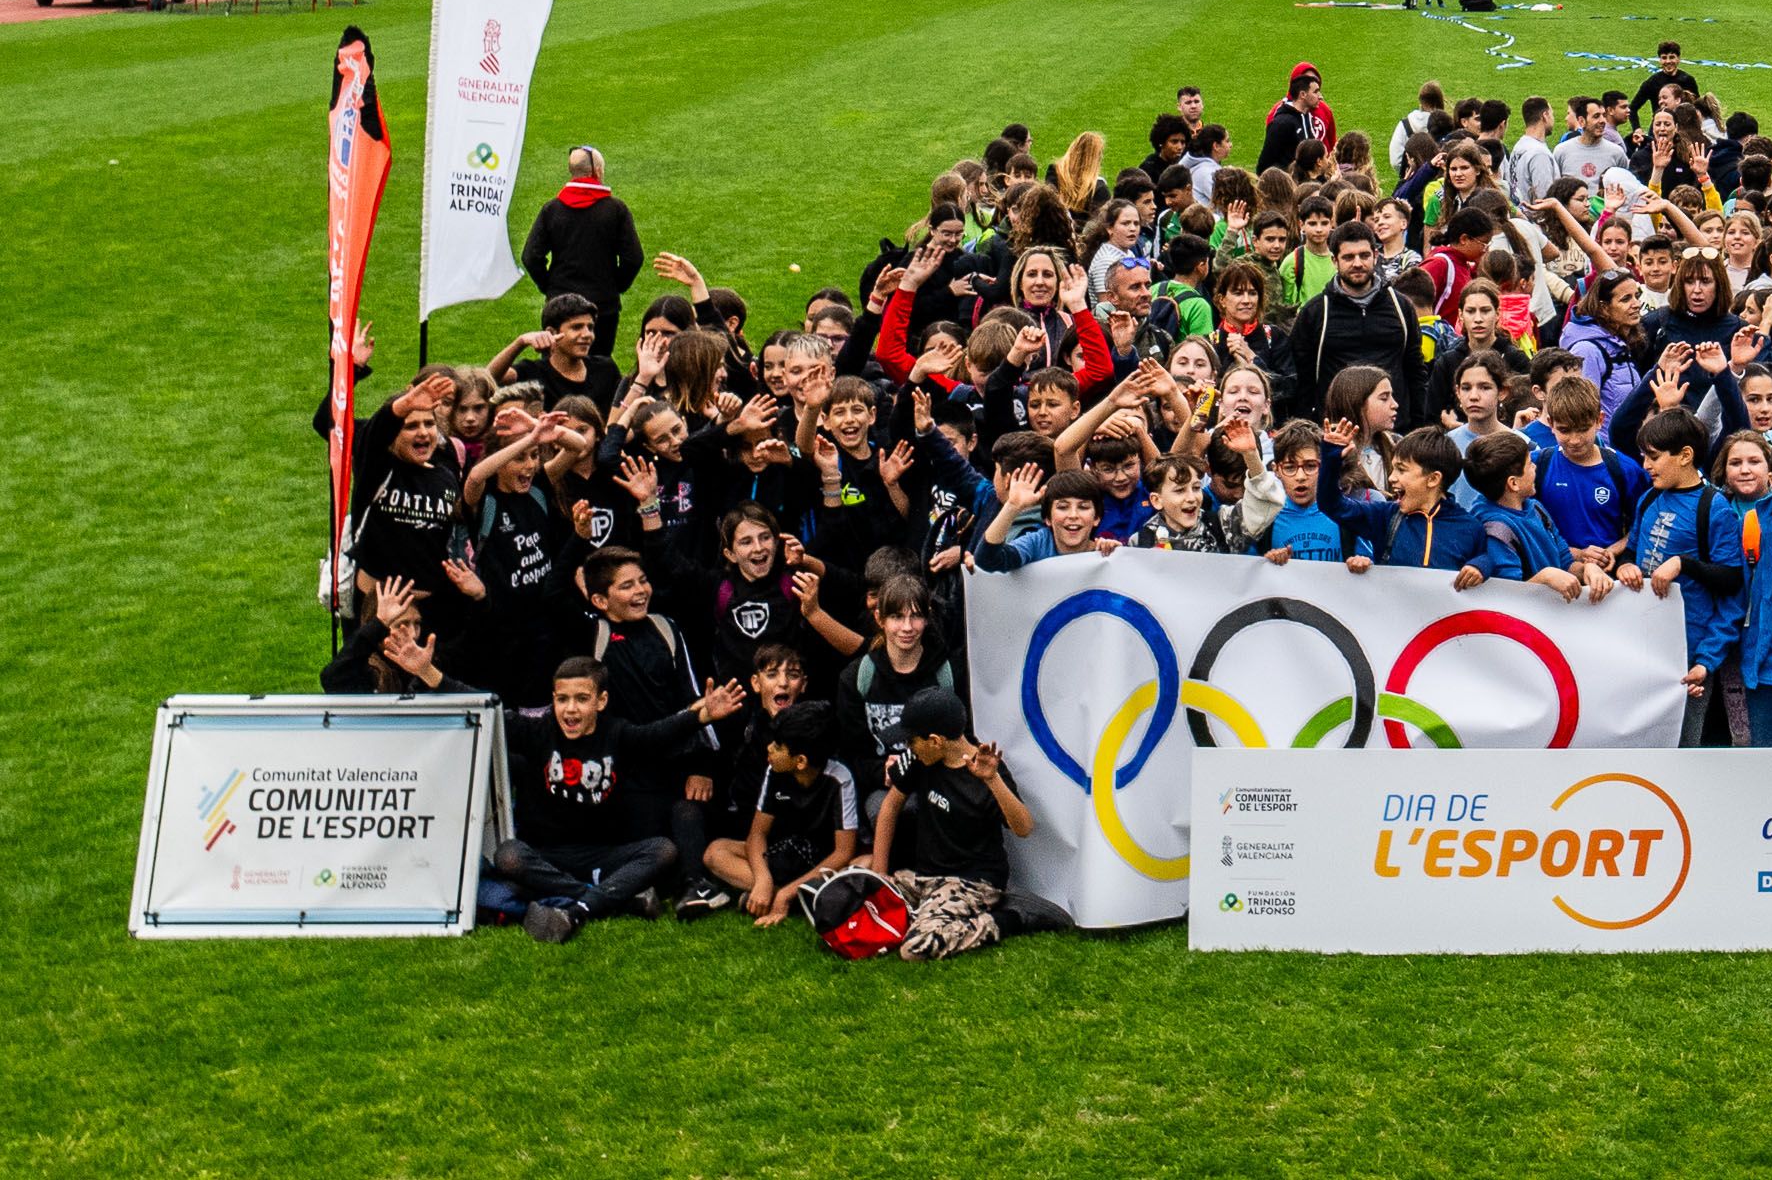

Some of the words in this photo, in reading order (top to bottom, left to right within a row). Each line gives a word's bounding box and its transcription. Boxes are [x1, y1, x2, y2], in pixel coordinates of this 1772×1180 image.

[458, 77, 524, 93] GENERALITAT
[252, 767, 333, 784] Comunitat
[337, 767, 419, 784] Valenciana
[248, 787, 416, 813] COMUNITAT
[928, 790, 950, 813] NASA
[1235, 793, 1292, 803] COMUNITAT
[1239, 803, 1252, 812] DE
[1254, 803, 1299, 812] L'ESPORT
[1383, 794, 1436, 822] DIA
[1446, 794, 1489, 822] DE
[257, 815, 292, 840] DE
[302, 814, 436, 840] L'ESPORT
[1236, 842, 1295, 851] GENERALITAT
[1236, 852, 1294, 860] VALENCIANA
[1373, 827, 1665, 878] L'ESPORT
[341, 872, 388, 881] TRINIDAD
[340, 881, 387, 890] ALFONSO
[1247, 889, 1296, 897] FUNDACIÓN
[1247, 897, 1296, 907] TRINIDAD
[1247, 907, 1296, 916] ALFONSO
